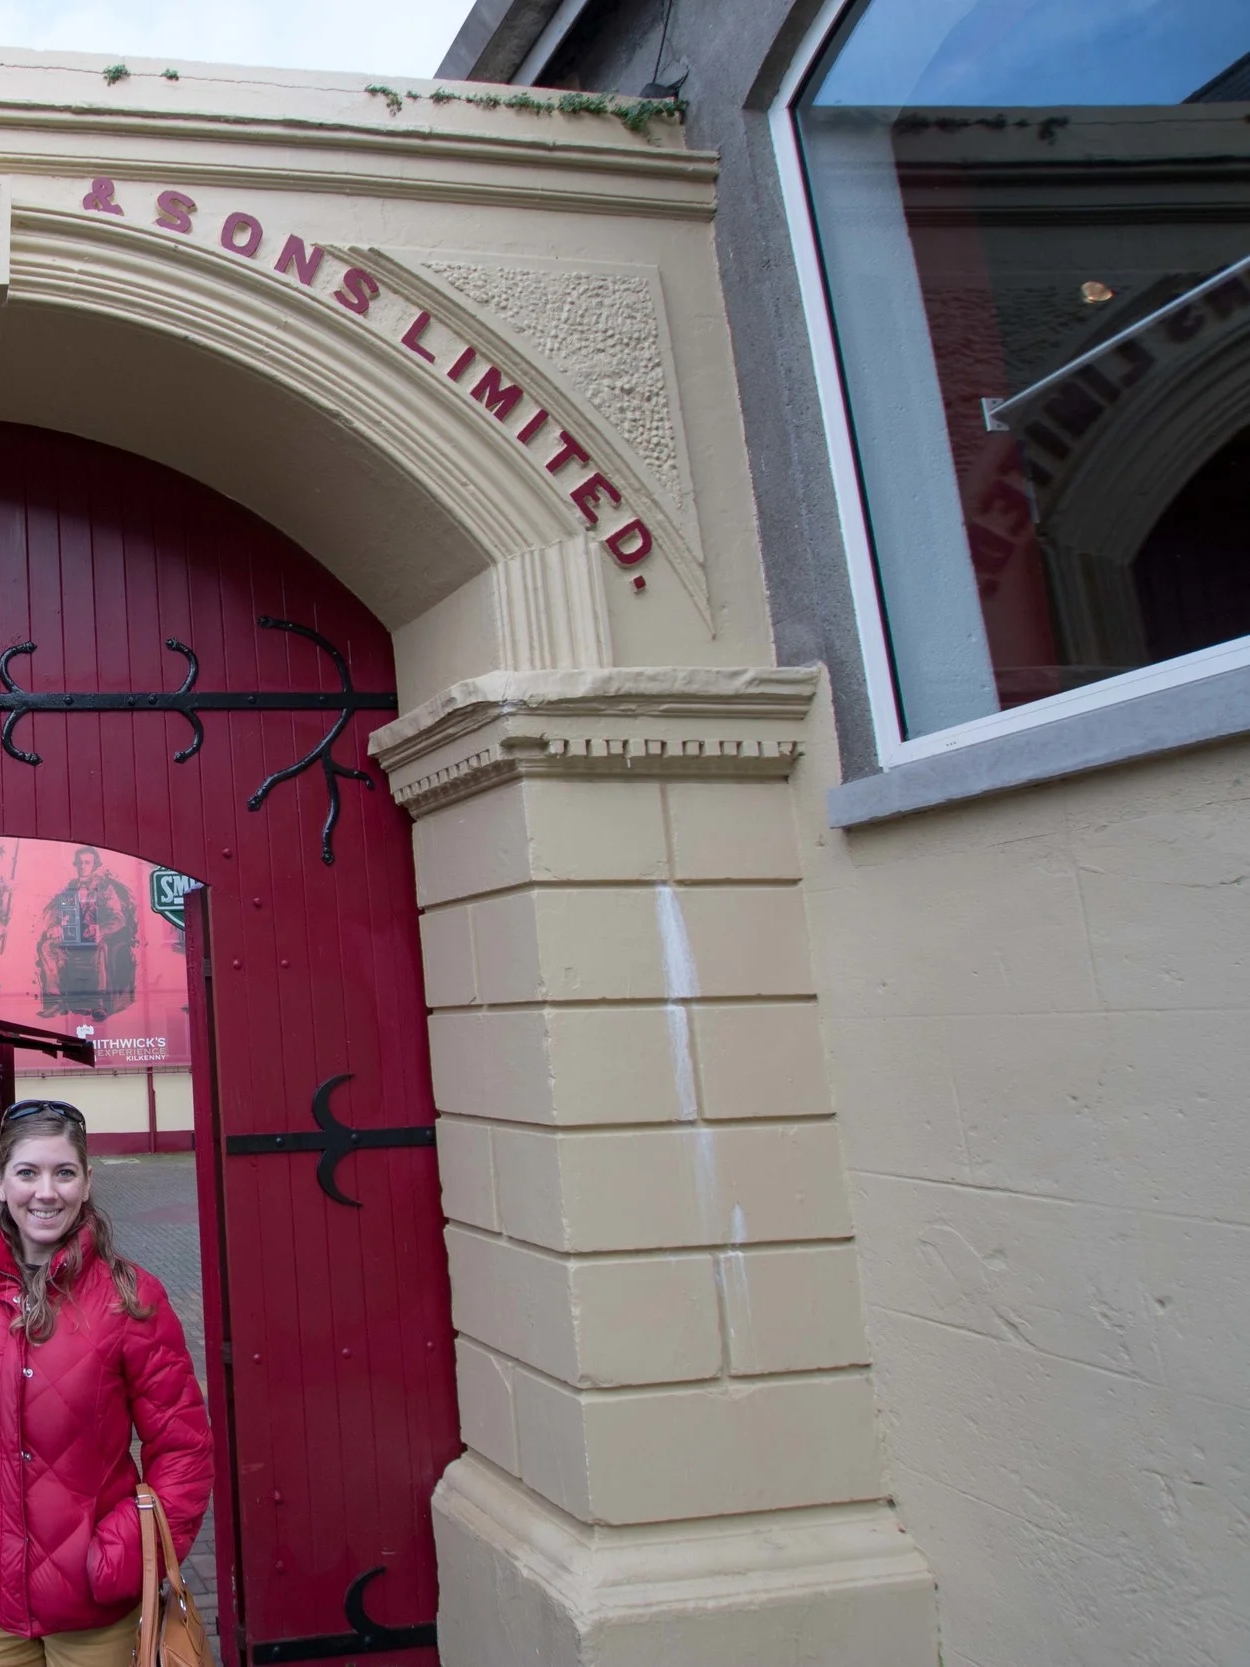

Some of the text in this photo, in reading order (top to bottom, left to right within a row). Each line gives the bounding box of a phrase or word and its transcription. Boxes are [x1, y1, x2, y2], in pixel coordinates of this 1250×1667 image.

[82, 177, 654, 593] & SONS LIMITED.
[97, 1047, 166, 1057] EXPERIENCE
[126, 1054, 166, 1062] KILKENNY
